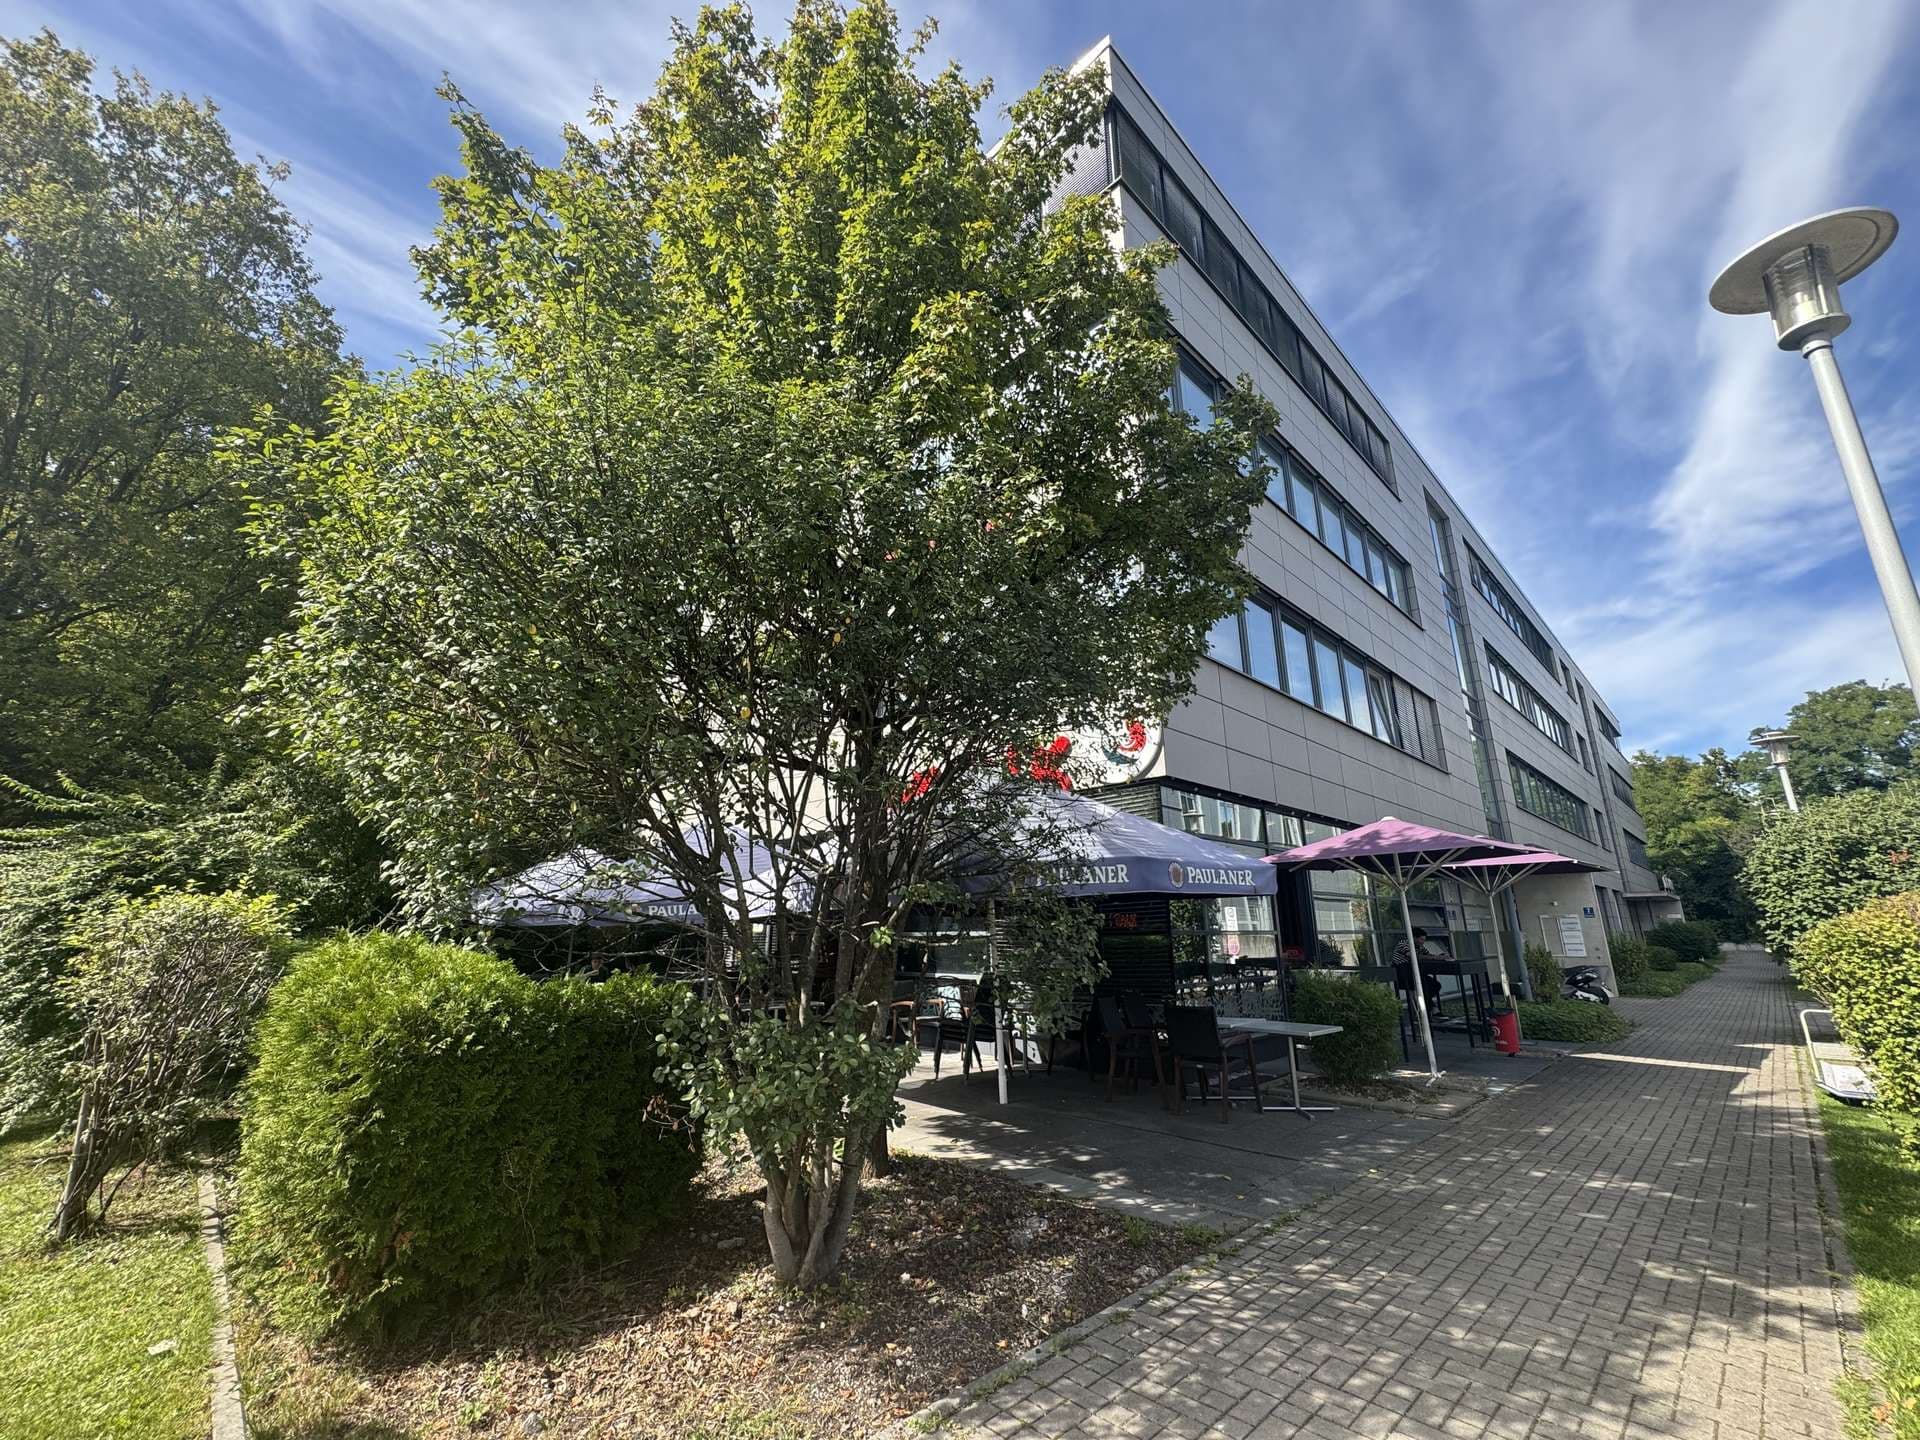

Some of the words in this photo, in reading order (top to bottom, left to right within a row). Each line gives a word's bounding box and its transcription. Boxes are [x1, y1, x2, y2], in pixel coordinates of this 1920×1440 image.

[1035, 864, 1130, 887] UANER
[1185, 866, 1257, 887] PAULANER
[647, 903, 699, 917] PAULA
